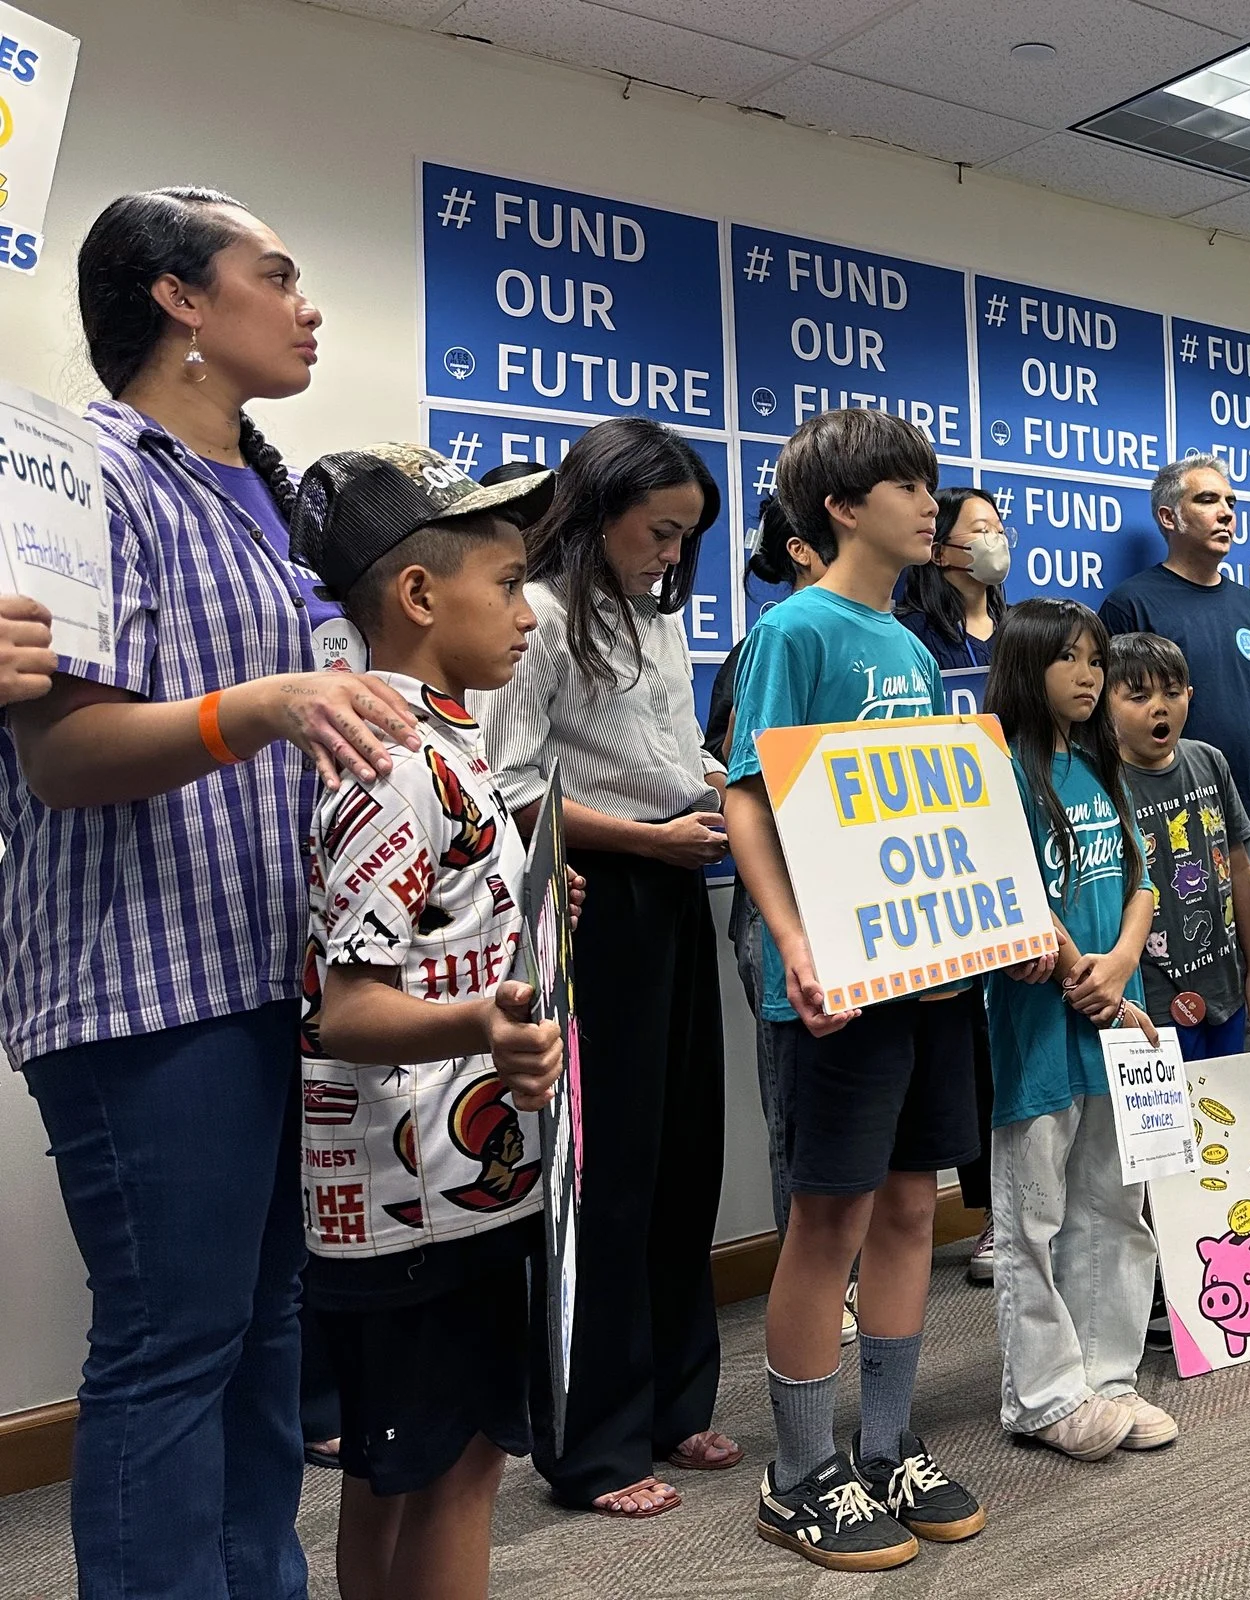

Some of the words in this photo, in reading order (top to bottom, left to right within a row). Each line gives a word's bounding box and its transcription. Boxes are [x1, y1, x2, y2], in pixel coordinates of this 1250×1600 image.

[437, 187, 477, 229] #
[495, 192, 646, 263] FUND
[496, 269, 616, 331] OUR
[743, 246, 773, 282] #
[788, 249, 908, 310] FUND
[791, 318, 886, 372] OUR
[985, 294, 1009, 327] #
[1020, 297, 1117, 350] FUND
[1180, 334, 1199, 363] #
[498, 343, 711, 416] FUTURE
[1022, 358, 1098, 406] OUR
[1024, 416, 1160, 471] FUTURE
[61, 461, 91, 509] Our
[1025, 487, 1122, 533] FUND
[1027, 547, 1104, 589] OUR
[323, 637, 348, 650] FUND
[862, 665, 878, 705] I
[883, 675, 909, 697] am
[830, 746, 983, 819] FUND
[1093, 793, 1112, 818] the
[1136, 806, 1155, 819] OSE
[1156, 798, 1180, 813] YOUR
[345, 821, 415, 894] FINEST
[879, 827, 977, 886] OUR
[857, 876, 1024, 960] FUTURE
[1184, 953, 1213, 973] CATCH
[1175, 999, 1198, 1023] MEDICAID
[1118, 1061, 1153, 1087] Fund
[1156, 1060, 1175, 1083] Our
[1125, 1088, 1183, 1112] rehabilitation
